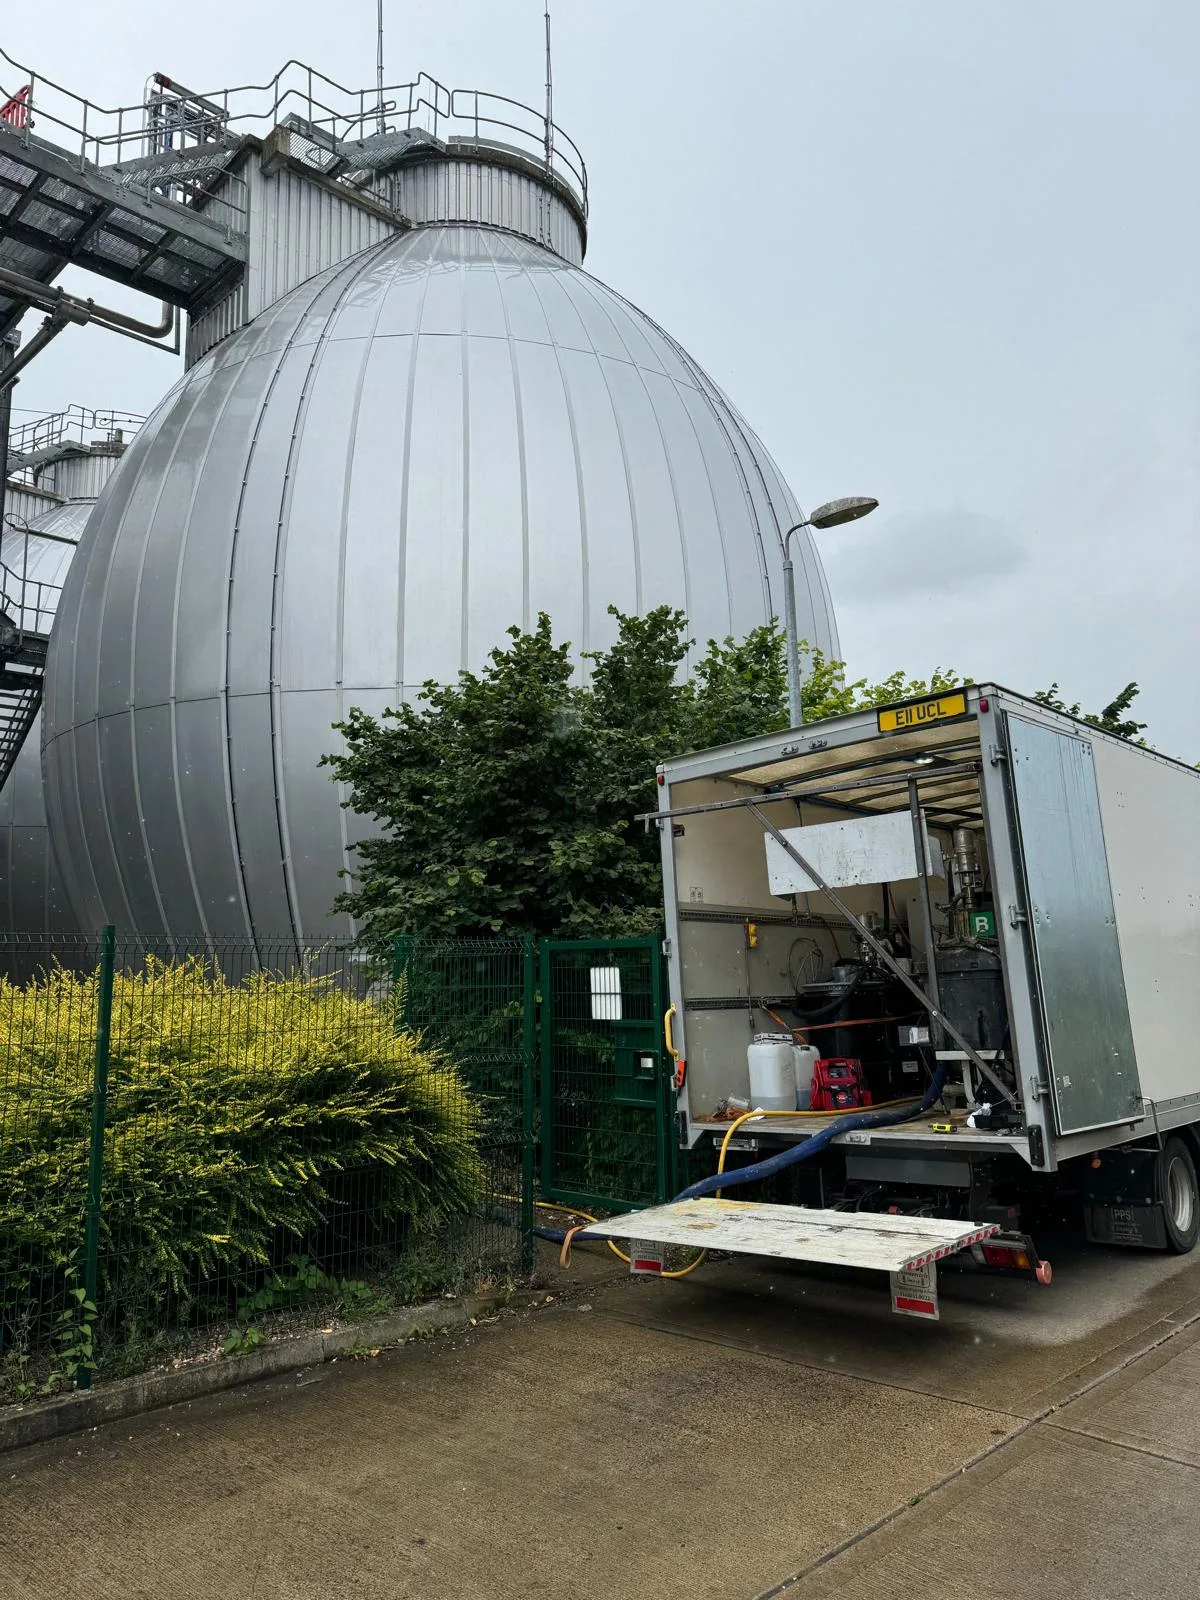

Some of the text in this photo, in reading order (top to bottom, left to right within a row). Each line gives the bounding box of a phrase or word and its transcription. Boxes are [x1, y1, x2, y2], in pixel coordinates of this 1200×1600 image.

[895, 701, 947, 726] E11 UCL
[975, 916, 989, 933] B
[1113, 1208, 1132, 1221] PPS
